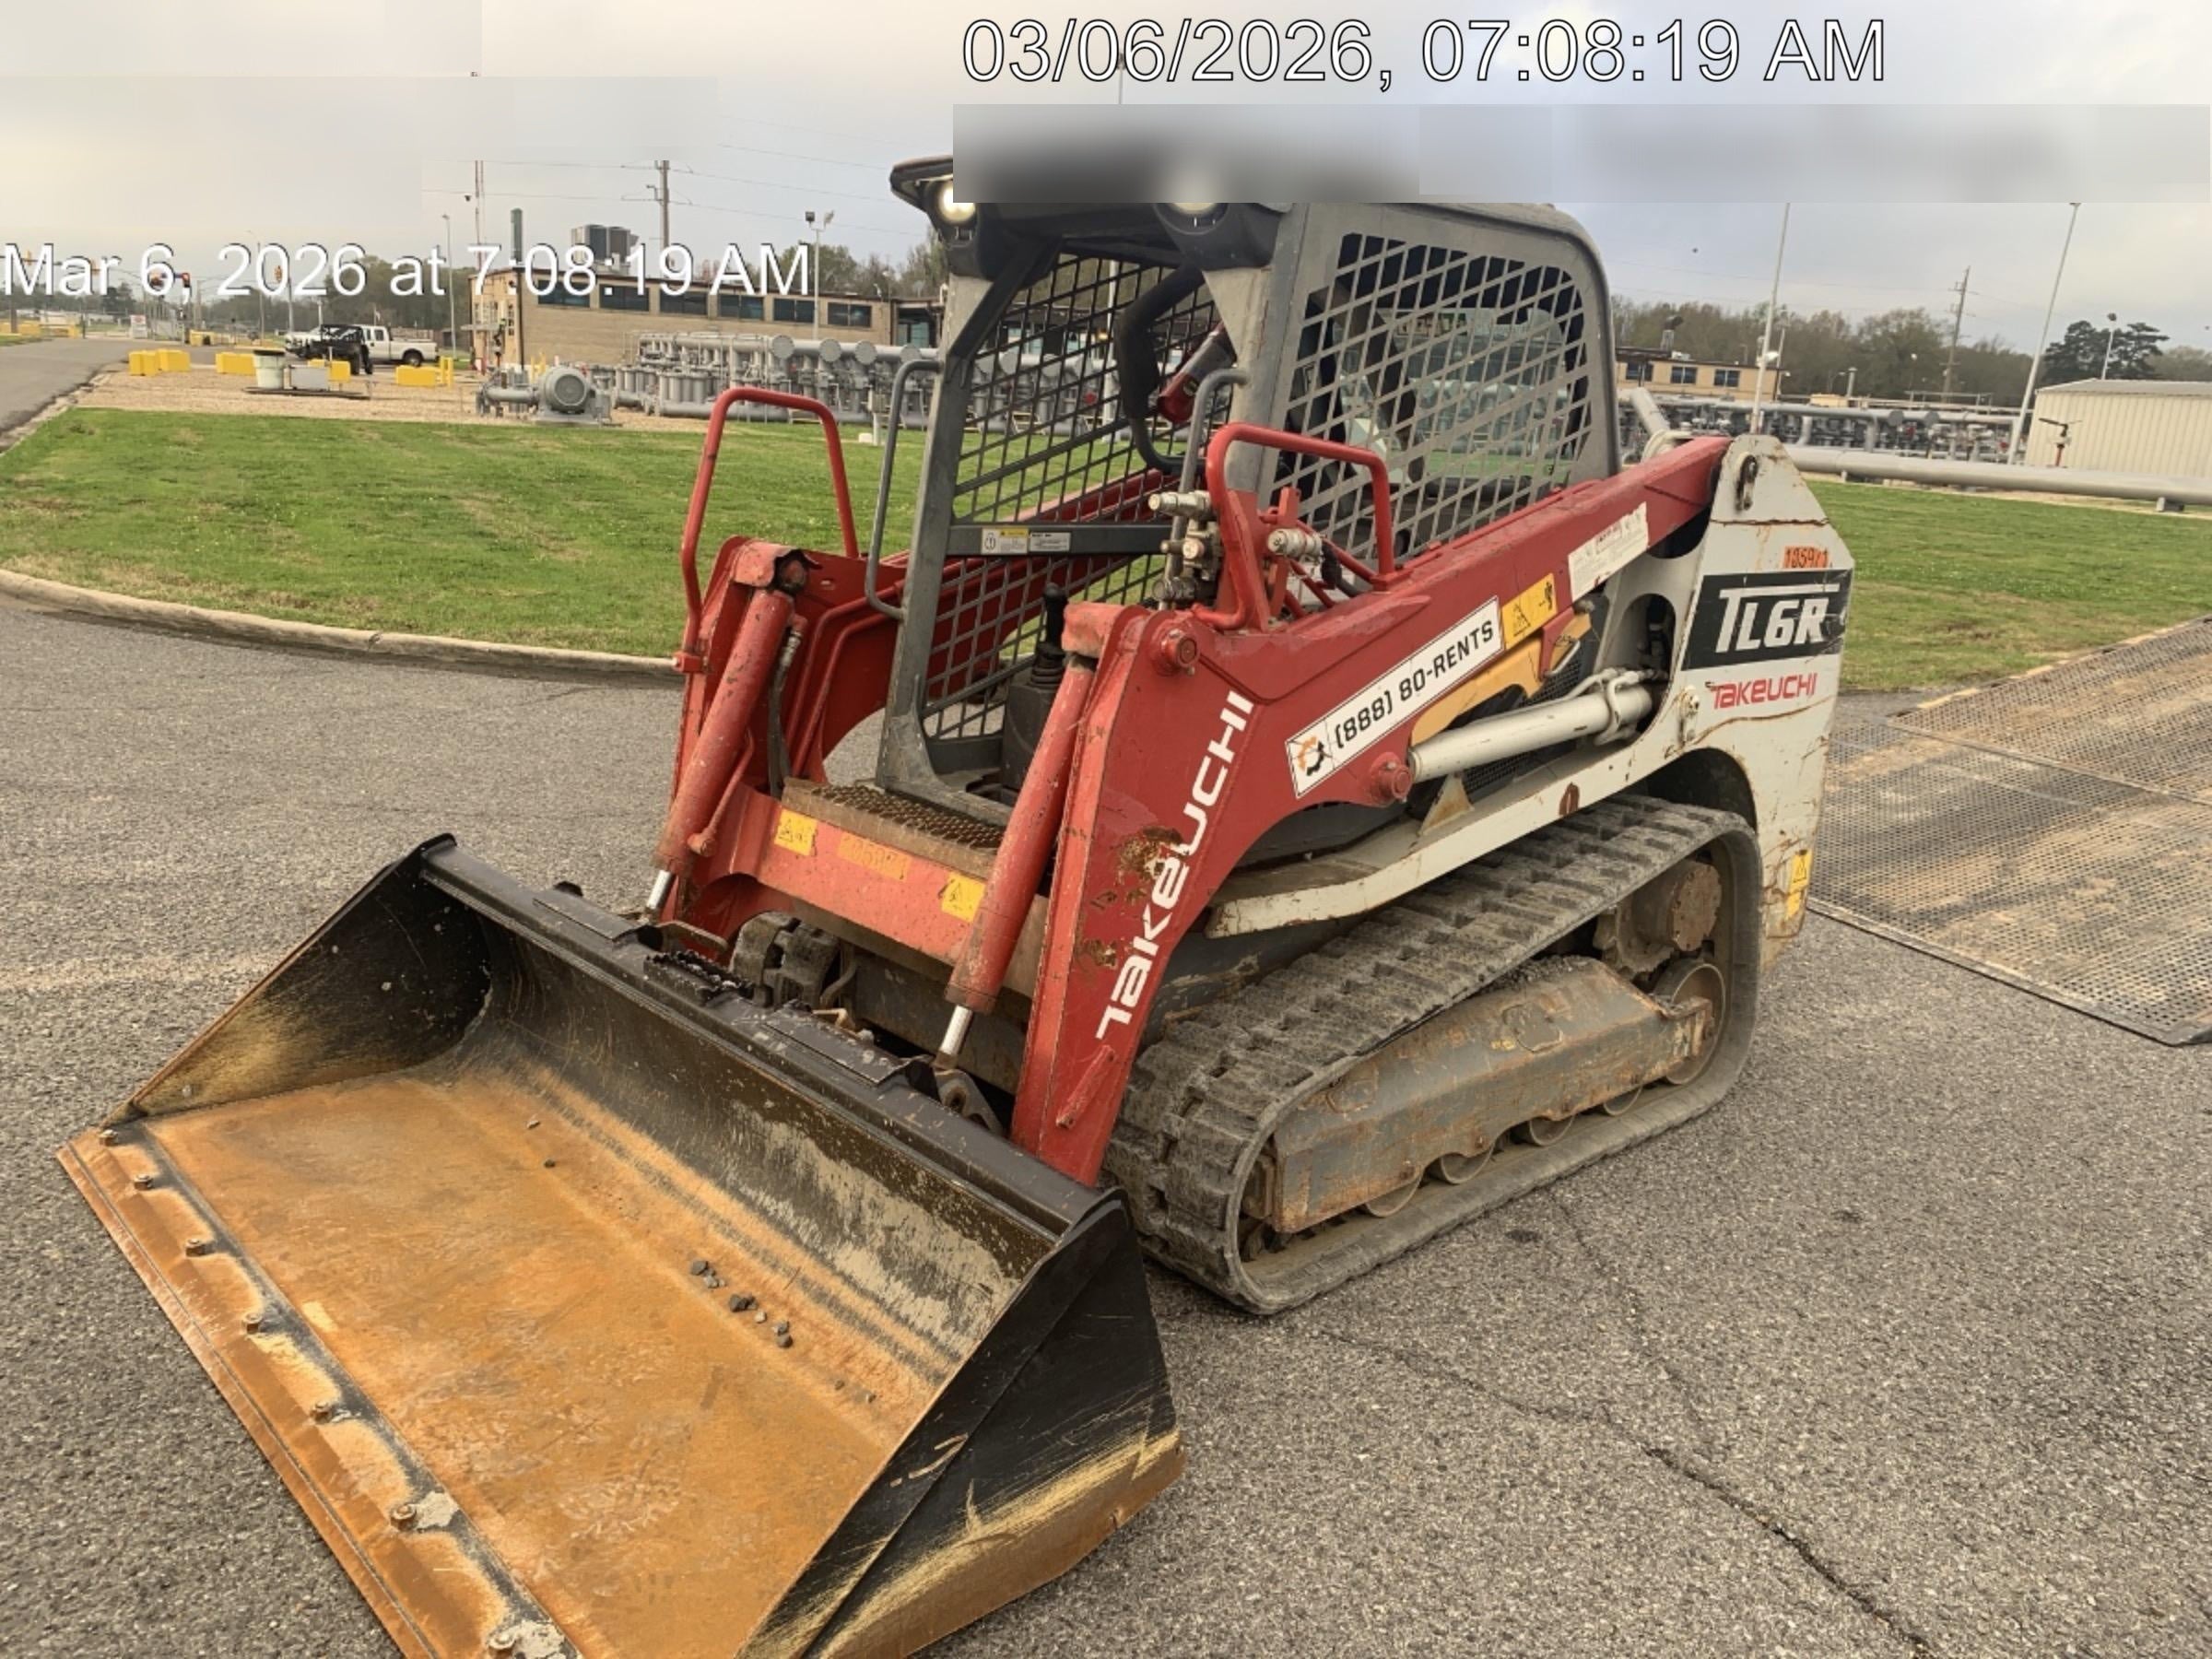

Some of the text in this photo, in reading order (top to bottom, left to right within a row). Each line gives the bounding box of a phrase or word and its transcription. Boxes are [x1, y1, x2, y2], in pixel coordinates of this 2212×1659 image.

[1714, 582, 1841, 653] TL6R
[1334, 619, 1494, 748] (888) 80-RENTS
